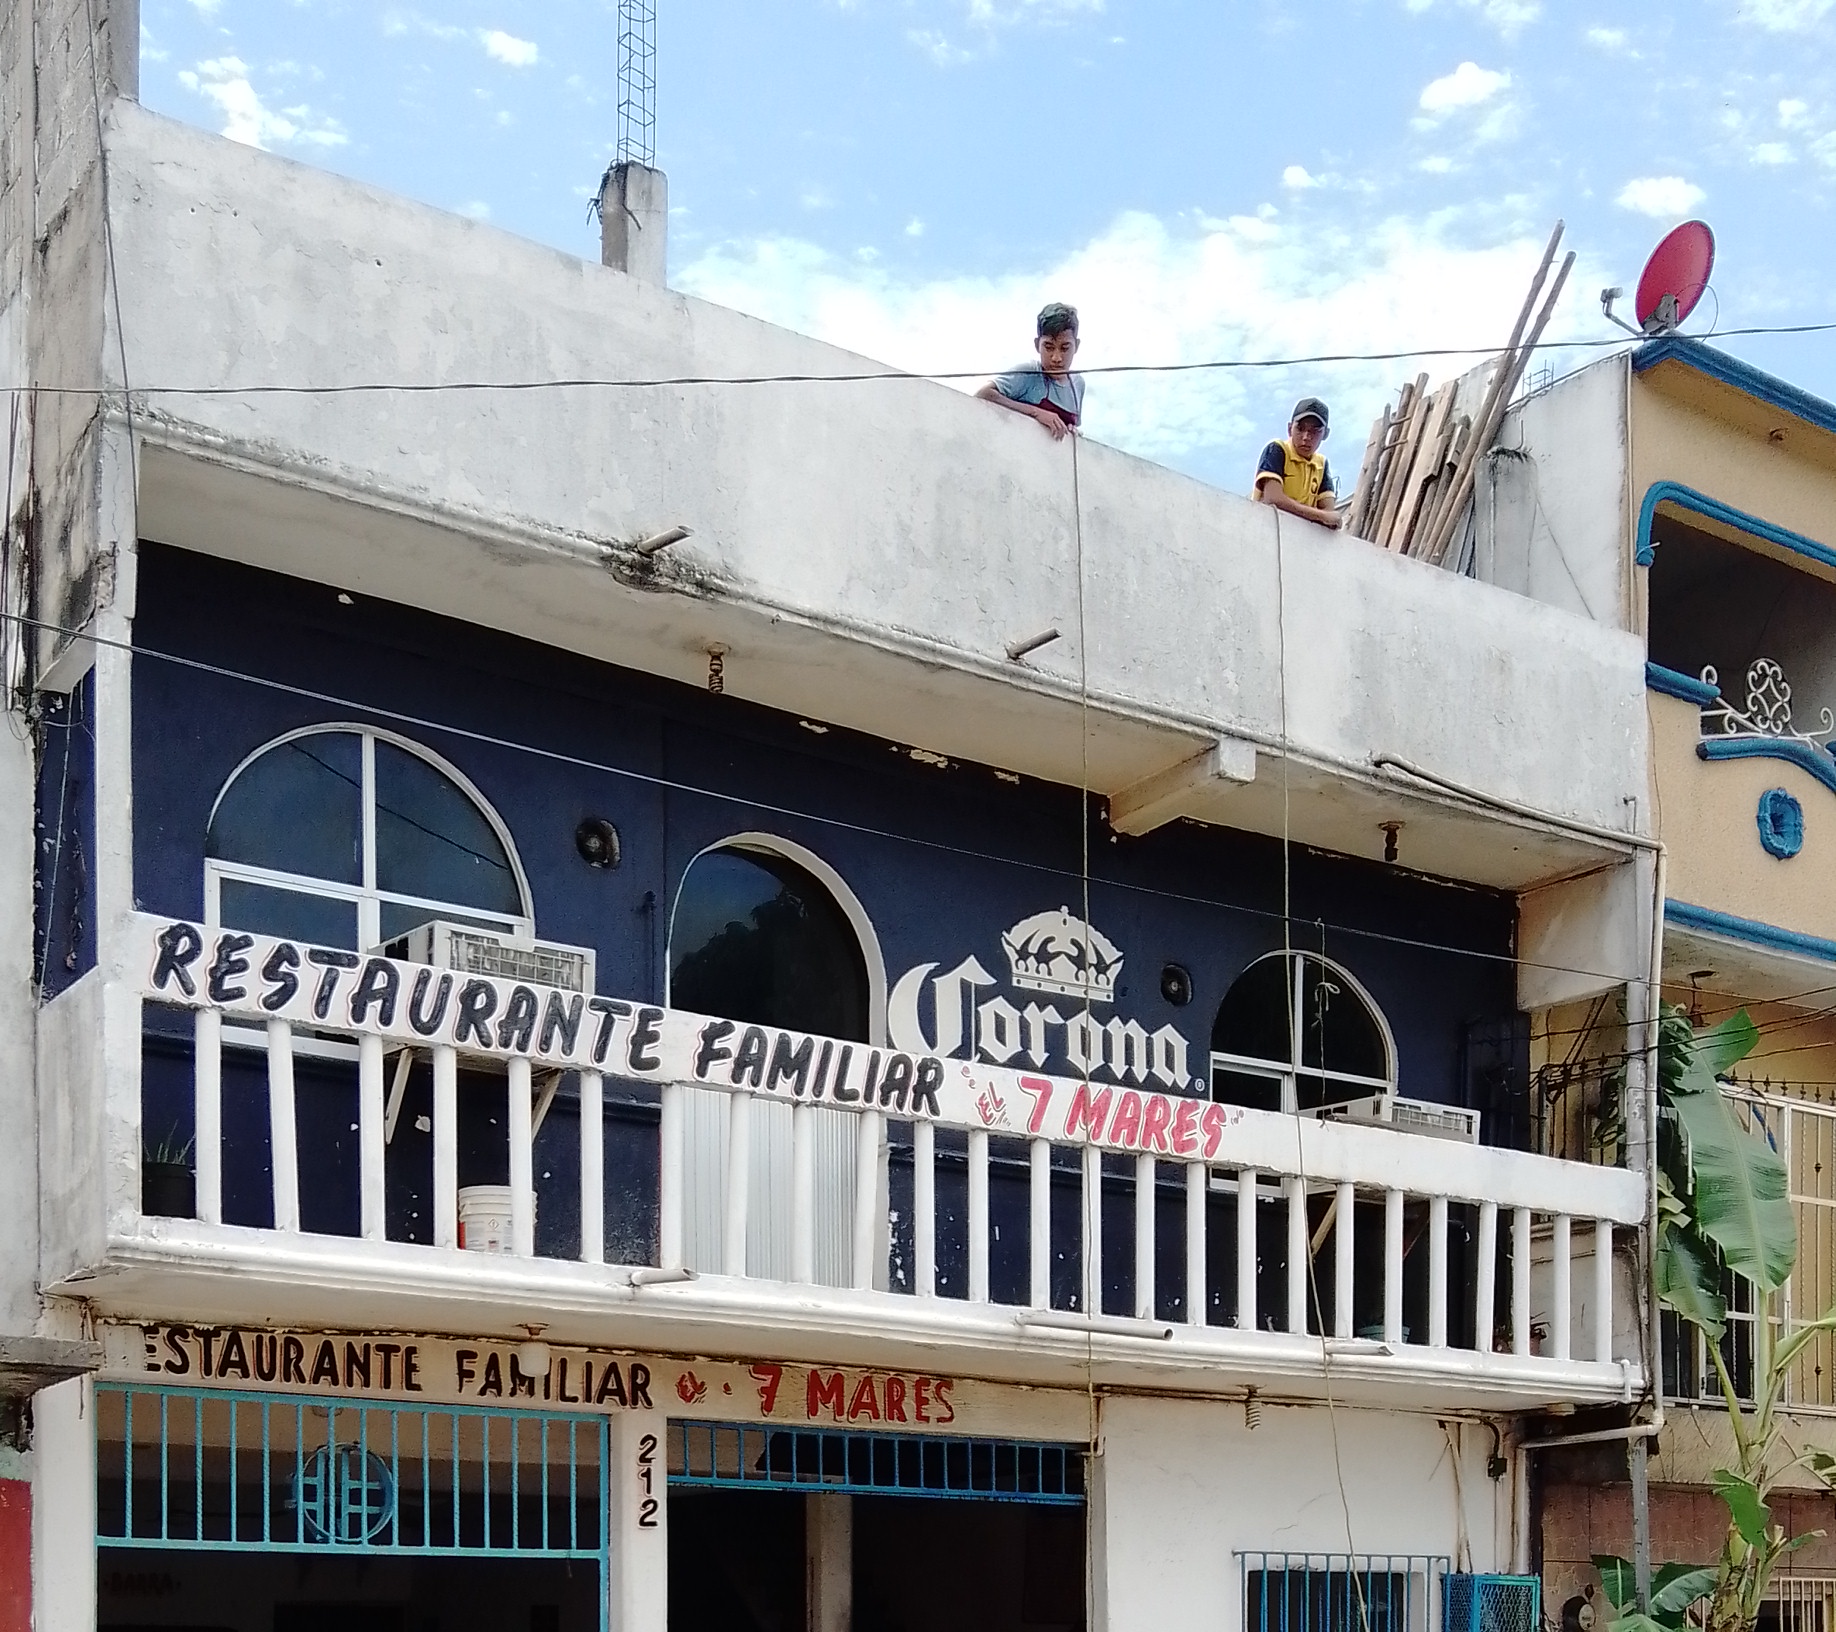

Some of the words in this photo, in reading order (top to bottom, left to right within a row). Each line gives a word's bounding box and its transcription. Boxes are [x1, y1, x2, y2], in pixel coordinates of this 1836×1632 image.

[153, 923, 665, 1072] RESTAURANTE
[693, 1020, 946, 1118] FAMILIAR
[1017, 1075, 1054, 1133] 7
[1066, 1084, 1229, 1159] MARES
[888, 954, 1198, 1091] Corona
[143, 1326, 424, 1392] ESTAURANTE
[747, 1364, 783, 1418] 7
[806, 1368, 956, 1425] MARES
[637, 1433, 660, 1529] 212
